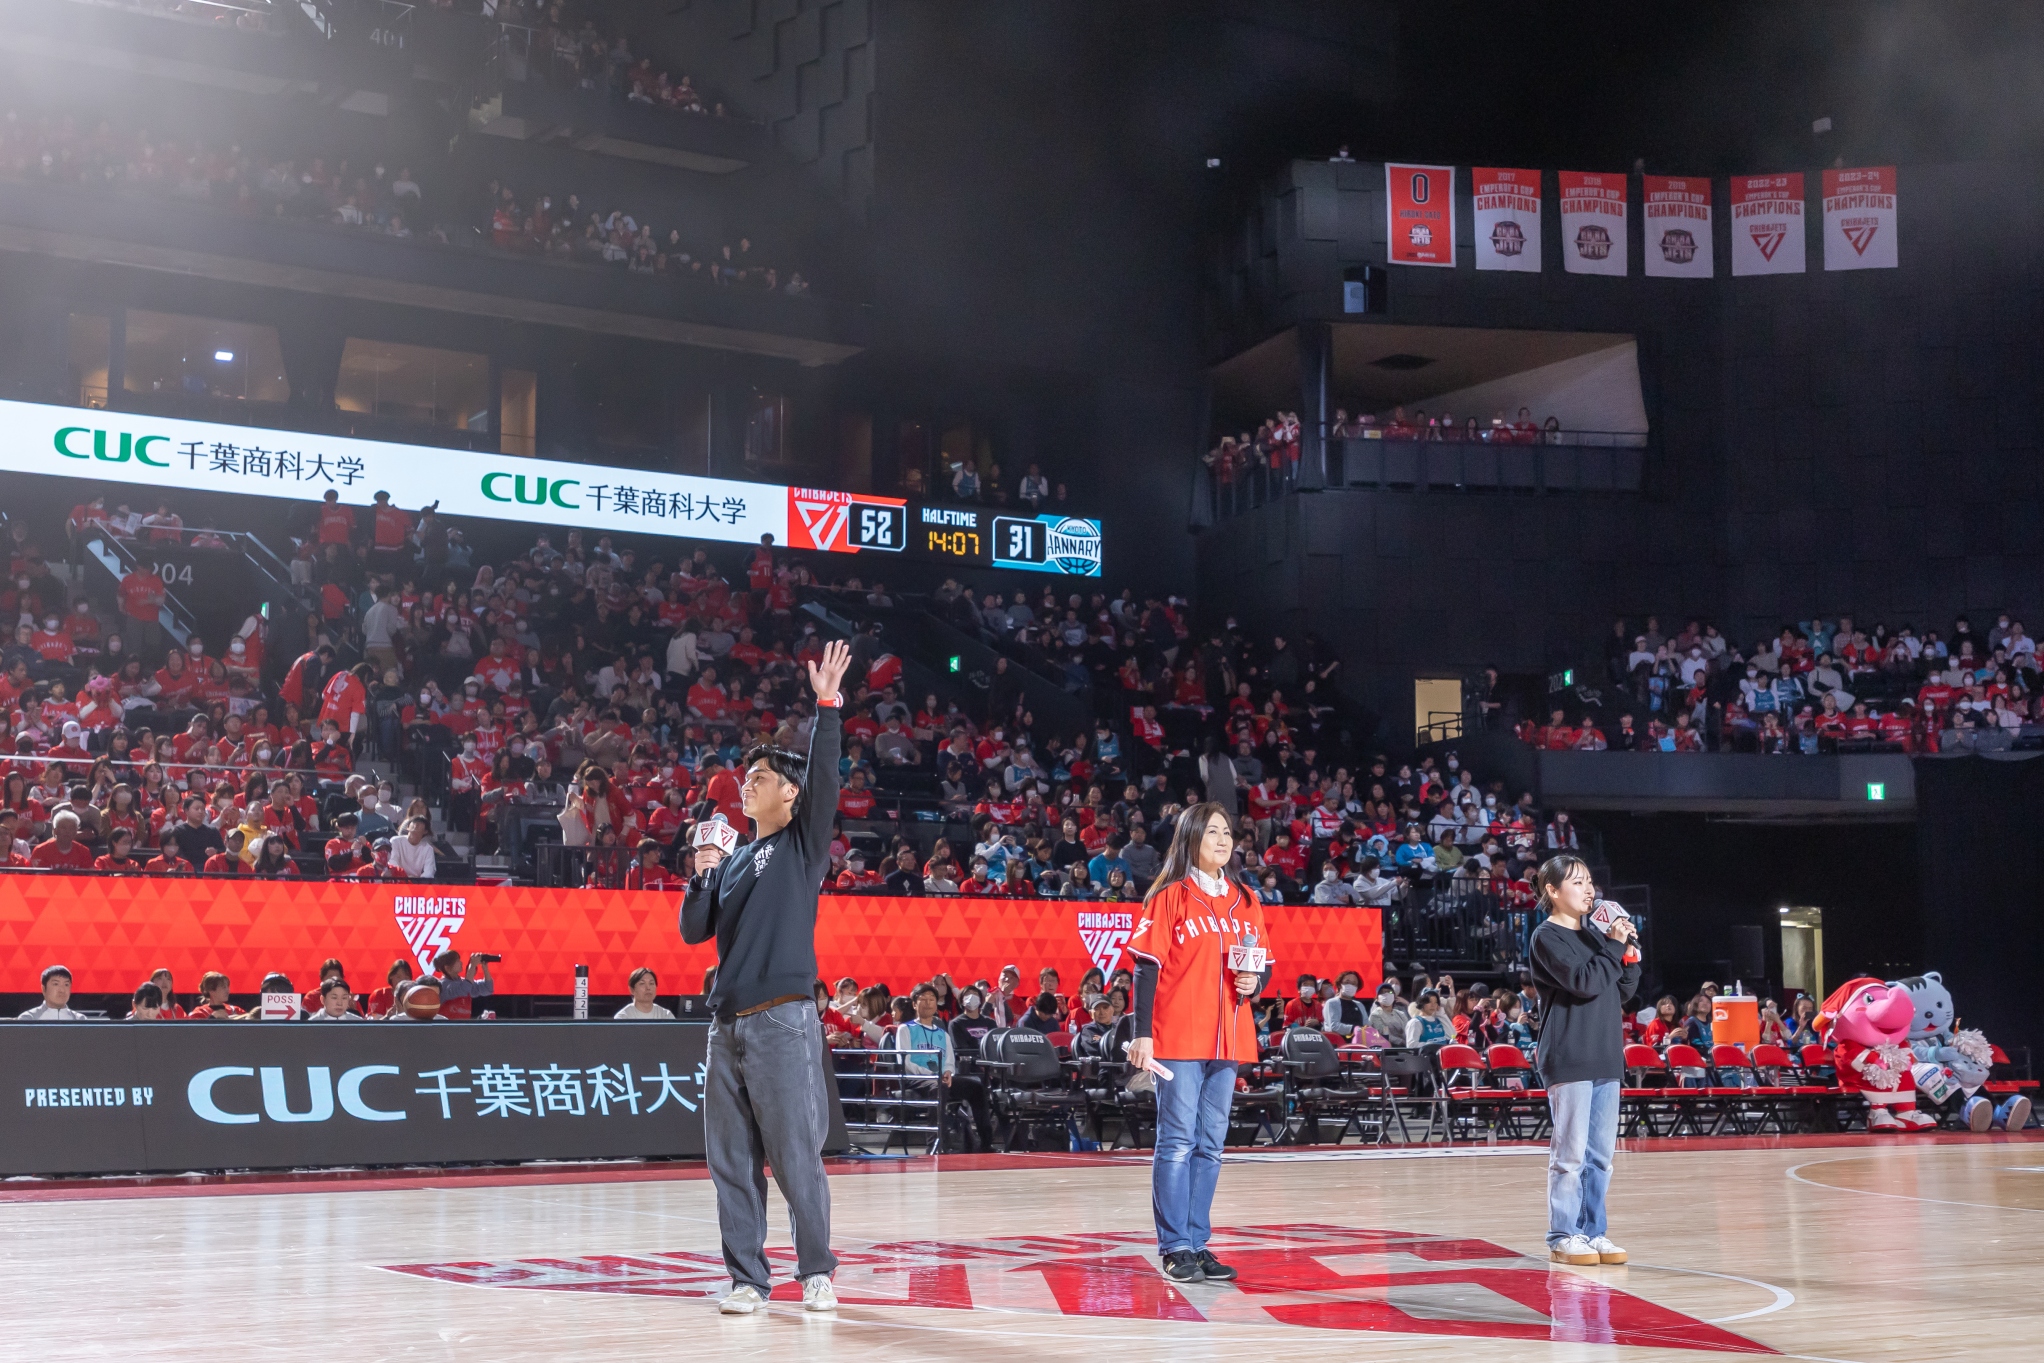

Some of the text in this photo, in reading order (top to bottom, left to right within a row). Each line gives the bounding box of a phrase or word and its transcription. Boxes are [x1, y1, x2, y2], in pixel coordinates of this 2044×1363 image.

[1497, 172, 1516, 182] 2017
[1411, 172, 1430, 205] 0
[1477, 197, 1537, 213] CHAMPIONS
[1562, 200, 1623, 217] CHAMPIONS
[1647, 204, 1708, 220] CHAMPIONS
[1735, 201, 1801, 219] CHAMPIONS
[1826, 195, 1893, 213] CHAMPIONS
[53, 426, 365, 486] CUC 千葉商科大学
[480, 472, 747, 525] CUC 千葉商科大学
[922, 507, 977, 527] HALFTIME
[861, 508, 892, 545] 52
[928, 531, 980, 556] 14:07
[1009, 524, 1032, 559] 31
[394, 896, 466, 916] CHIBAJETS
[1077, 912, 1133, 929] CHIBAJETS
[580, 978, 587, 987] 4
[267, 994, 296, 1004] POSS.
[580, 989, 587, 998] 3
[580, 1000, 587, 1009] 2
[580, 1010, 587, 1019] 1
[25, 1086, 154, 1107] PRESENTED BY
[187, 1061, 706, 1125] CUC 千葉商科大
